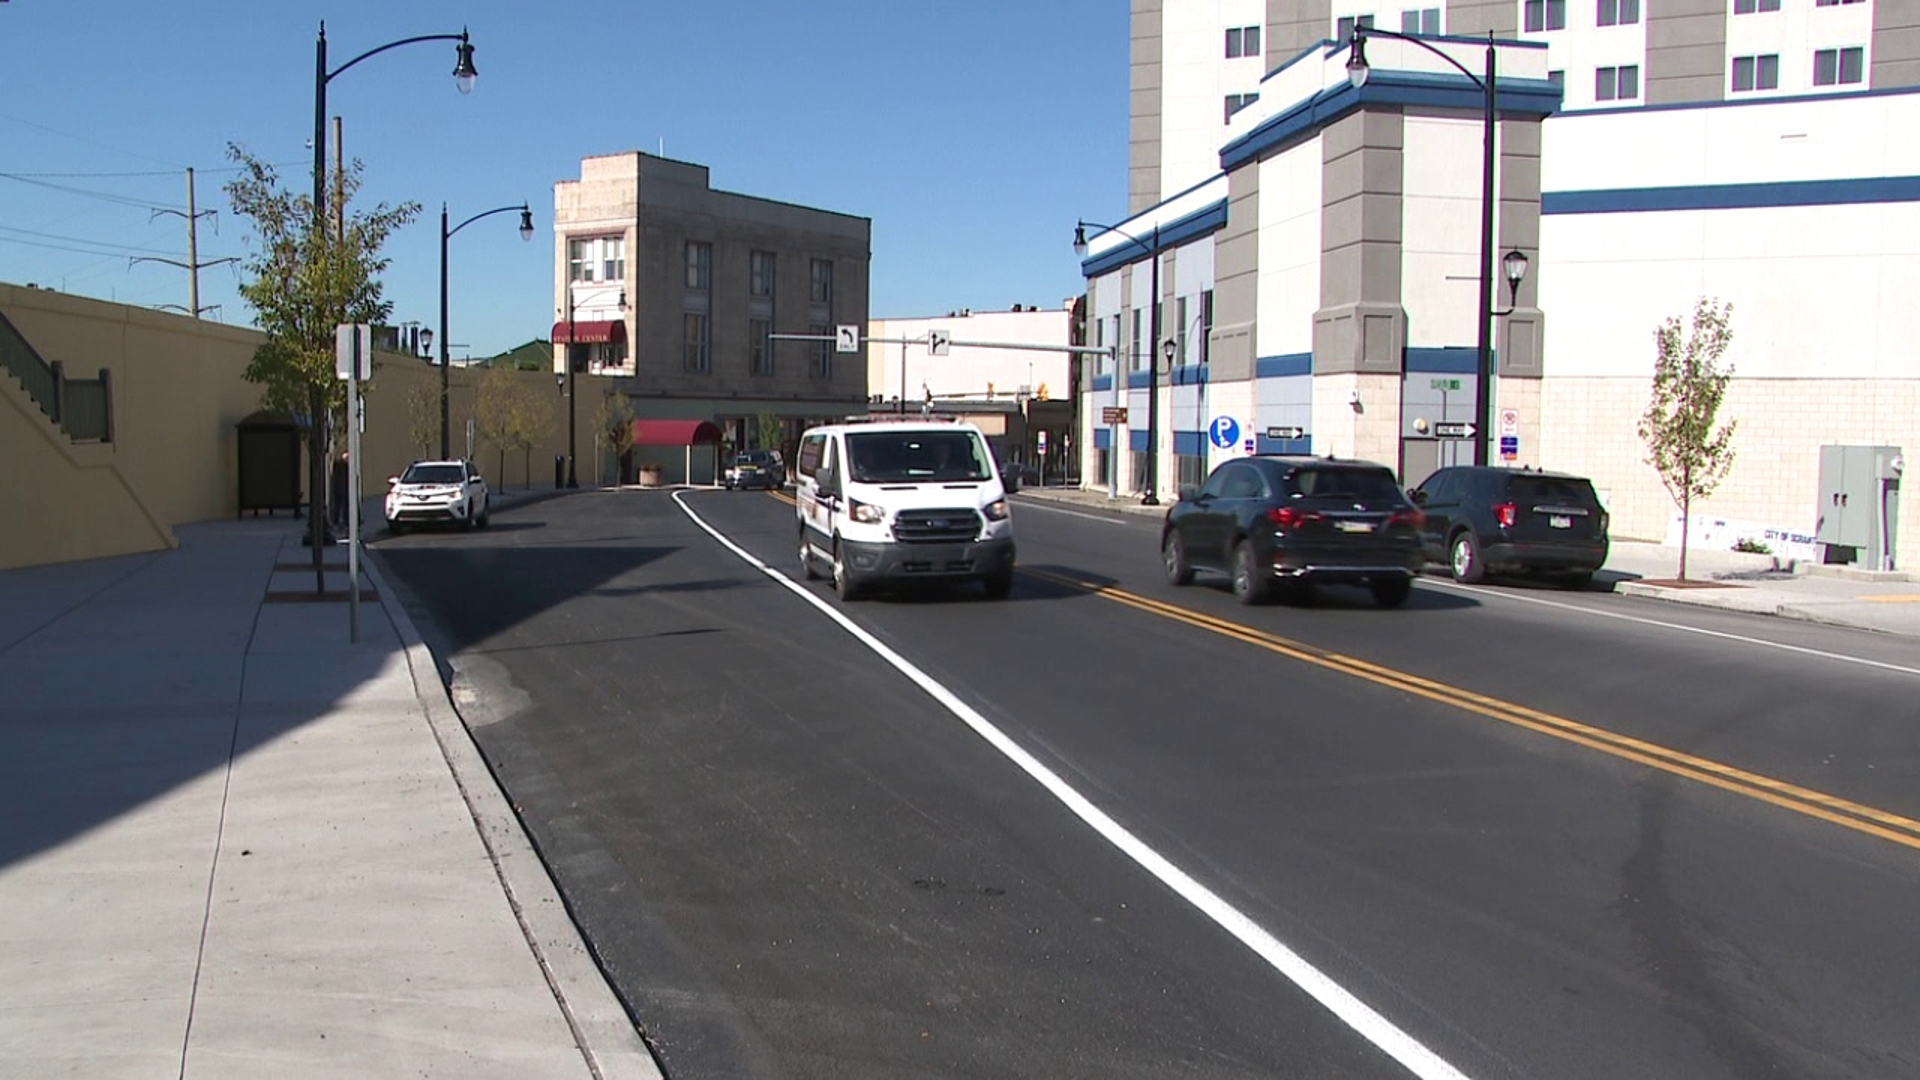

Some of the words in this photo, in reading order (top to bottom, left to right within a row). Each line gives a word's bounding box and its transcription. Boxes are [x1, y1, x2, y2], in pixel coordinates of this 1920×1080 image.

[553, 335, 579, 343] STATIN
[1765, 530, 1779, 539] CITY
[1781, 532, 1789, 541] OF
